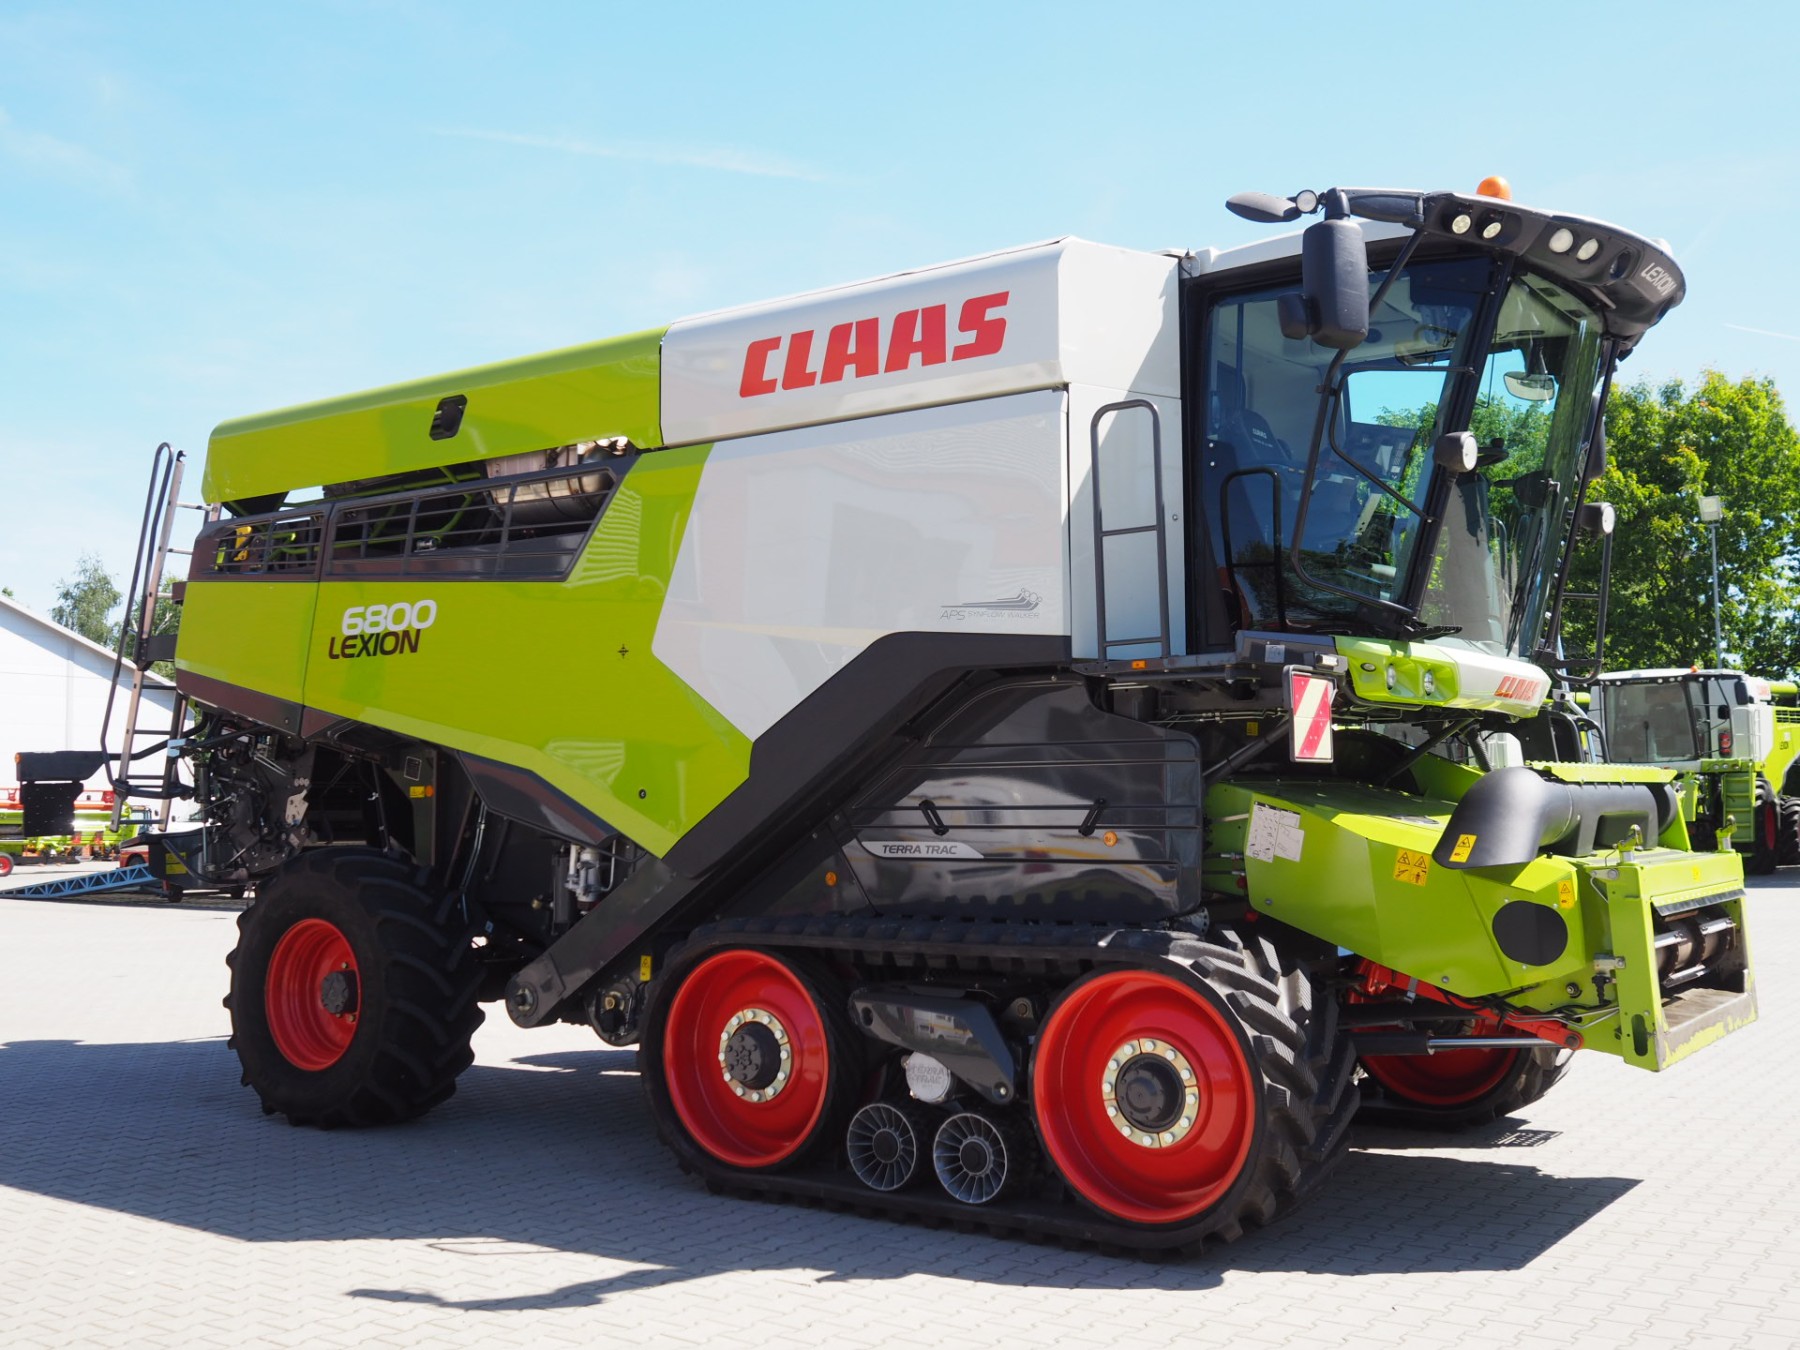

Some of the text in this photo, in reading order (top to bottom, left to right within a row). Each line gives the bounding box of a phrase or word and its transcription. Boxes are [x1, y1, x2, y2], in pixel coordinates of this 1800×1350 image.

[1641, 262, 1677, 296] LEXION
[739, 291, 1010, 398] CLAAS
[342, 599, 437, 636] 6800
[940, 609, 966, 620] APS
[328, 629, 421, 659] LEXION
[1494, 675, 1541, 701] CLAAS
[882, 844, 958, 855] TERRA TRAC
